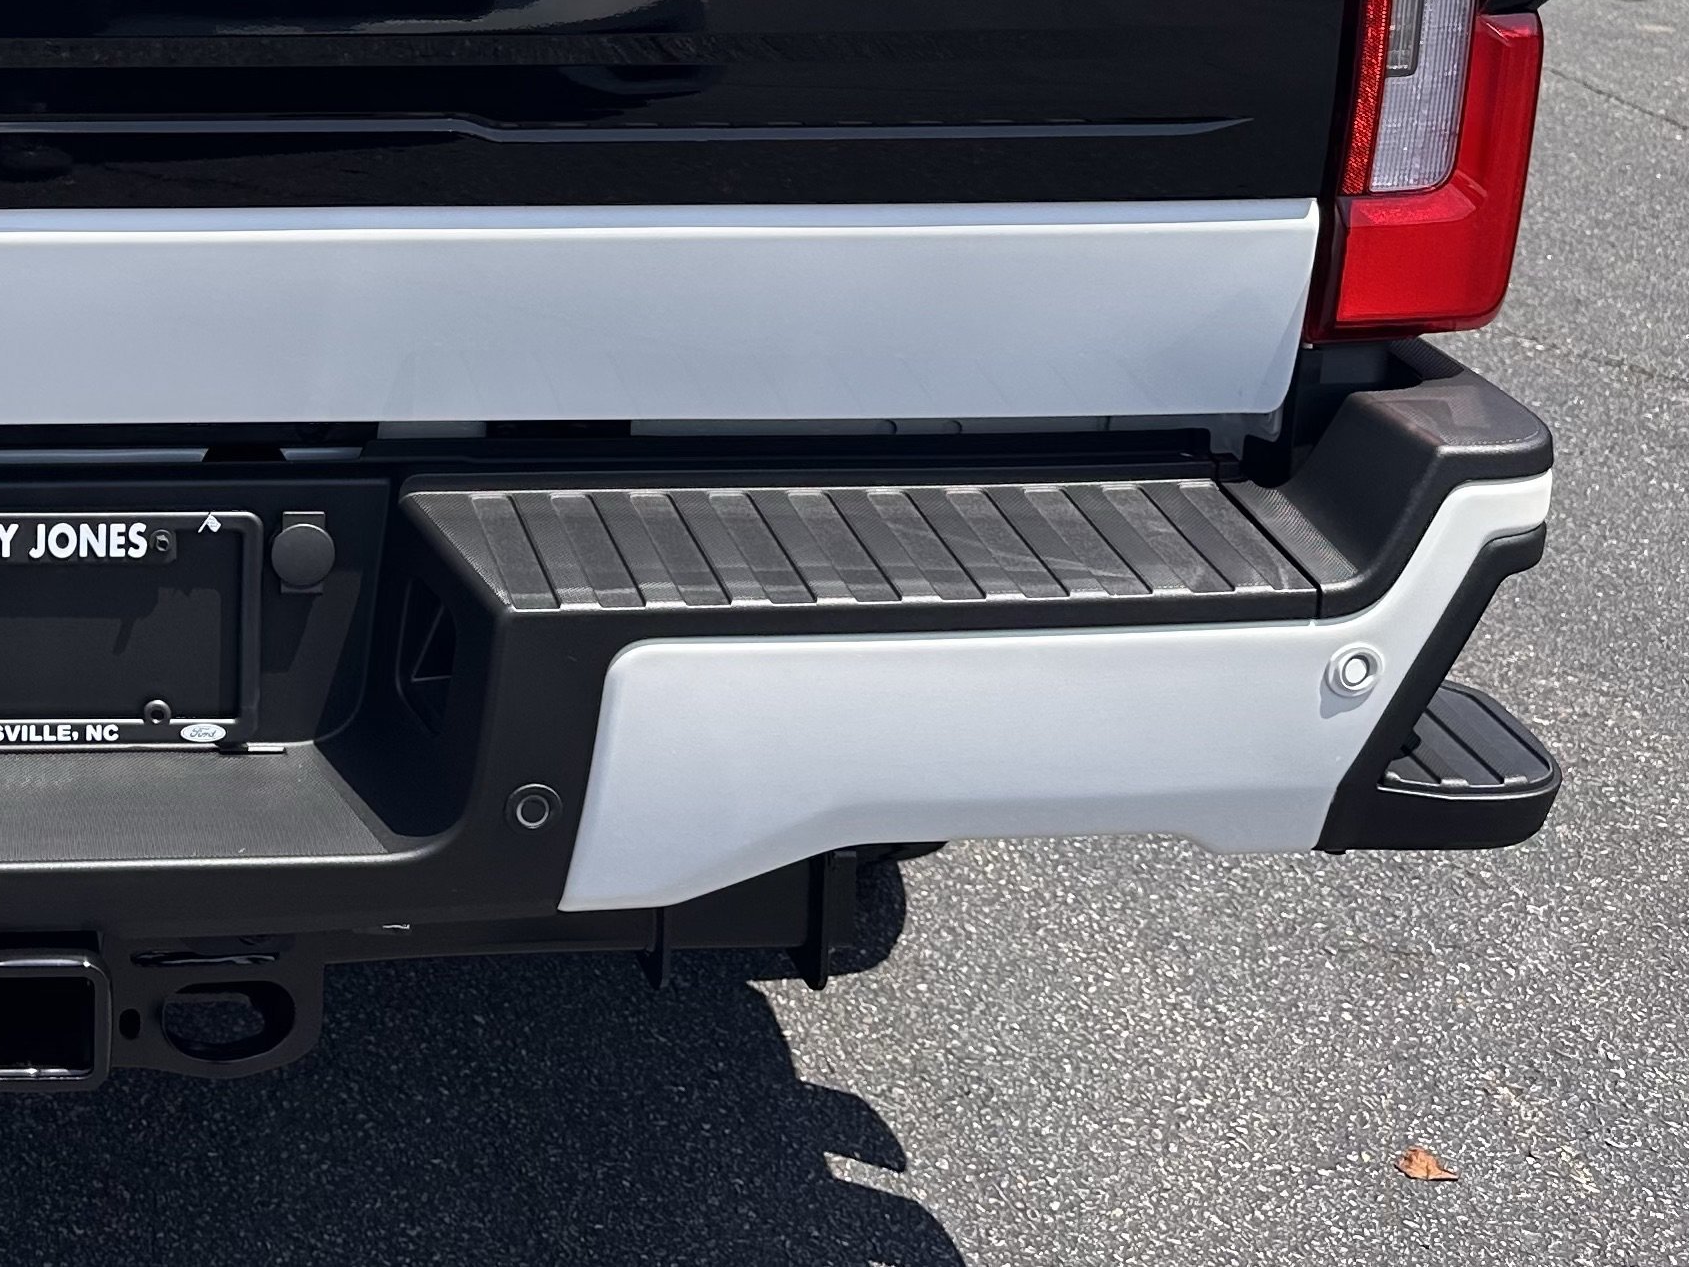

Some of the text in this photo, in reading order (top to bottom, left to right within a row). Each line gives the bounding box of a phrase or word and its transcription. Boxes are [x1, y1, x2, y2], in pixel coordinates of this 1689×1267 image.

[28, 522, 149, 560] JONES
[84, 723, 120, 742] NC
[189, 727, 217, 738] Ford
